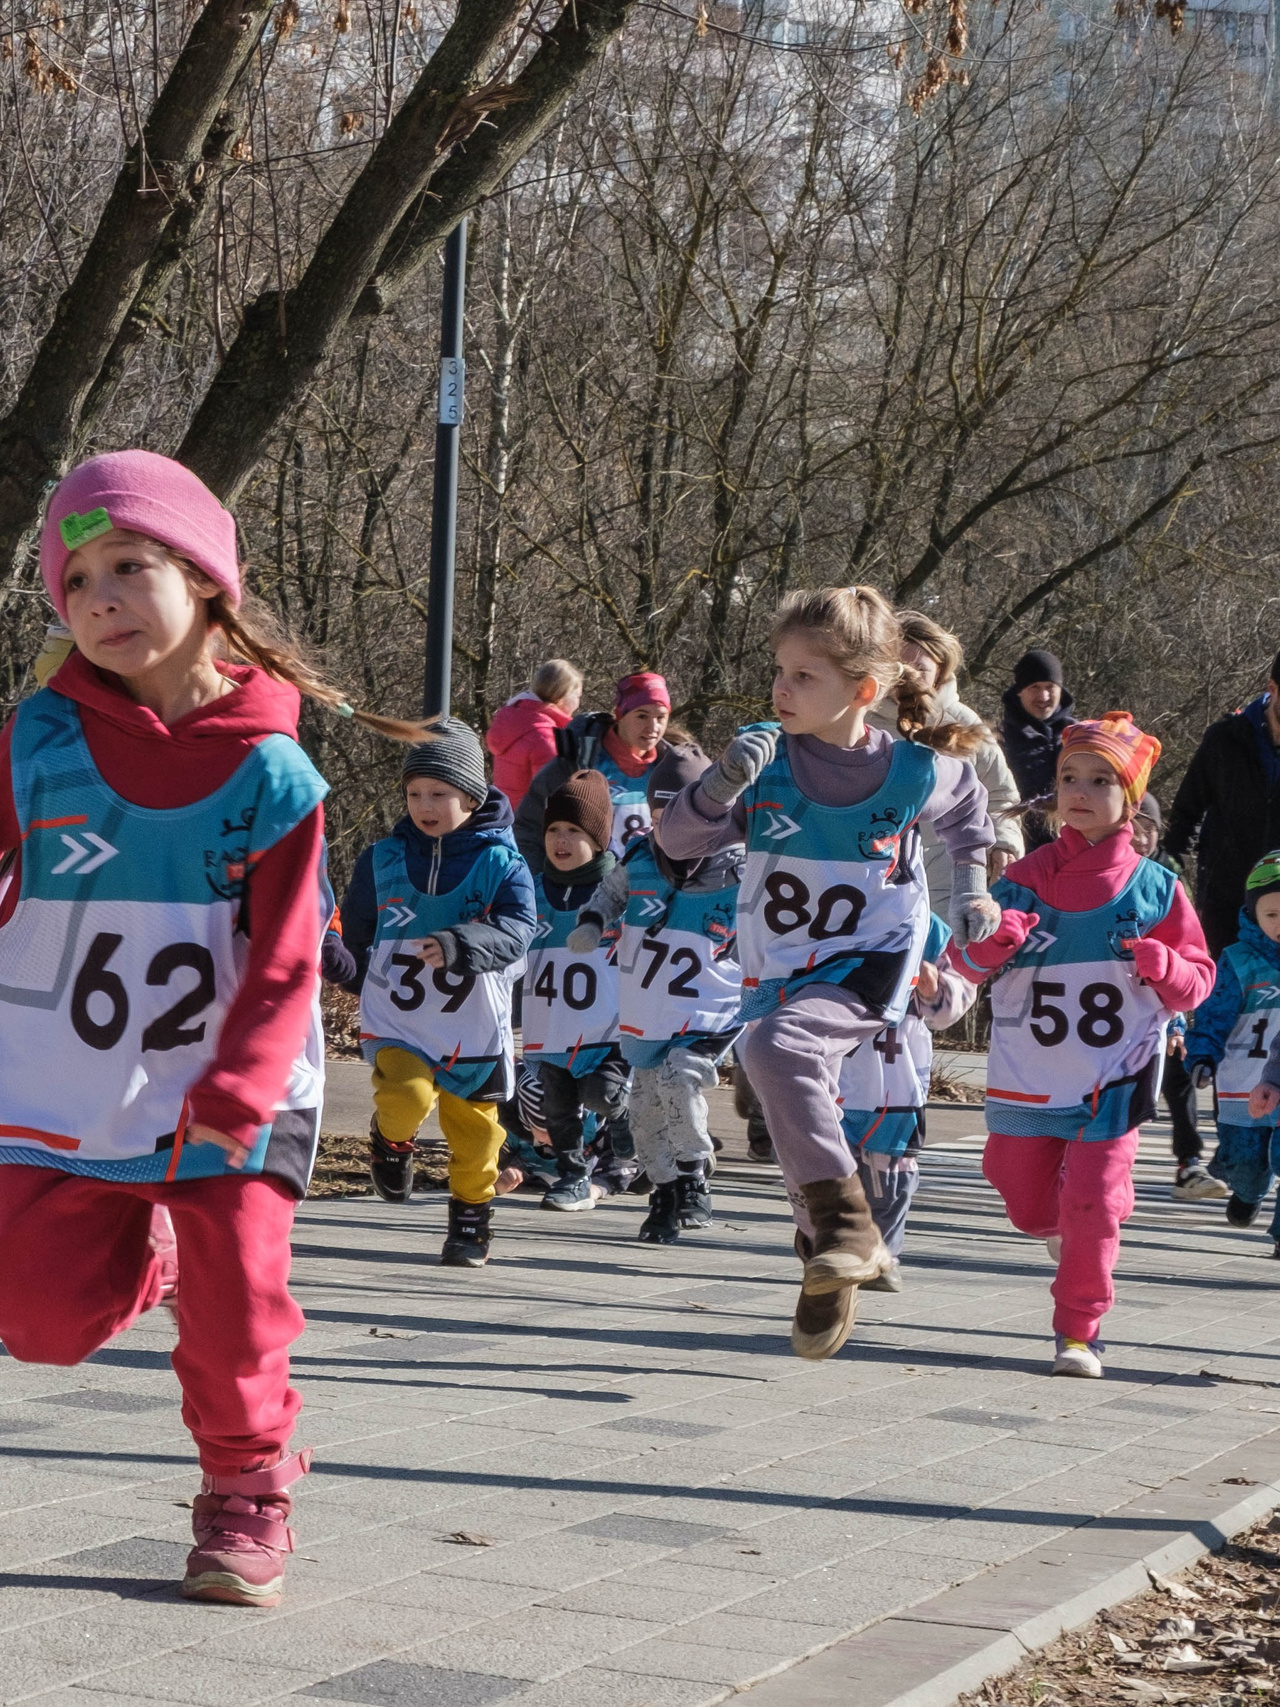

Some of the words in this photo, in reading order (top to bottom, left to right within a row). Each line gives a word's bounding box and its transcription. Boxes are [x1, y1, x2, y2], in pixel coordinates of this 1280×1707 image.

[448, 361, 458, 419] 325
[764, 871, 867, 941] 80
[71, 932, 217, 1053] 62
[389, 953, 476, 1013] 39
[534, 961, 597, 1010] 40
[641, 938, 702, 998] 72
[1030, 980, 1125, 1048] 58
